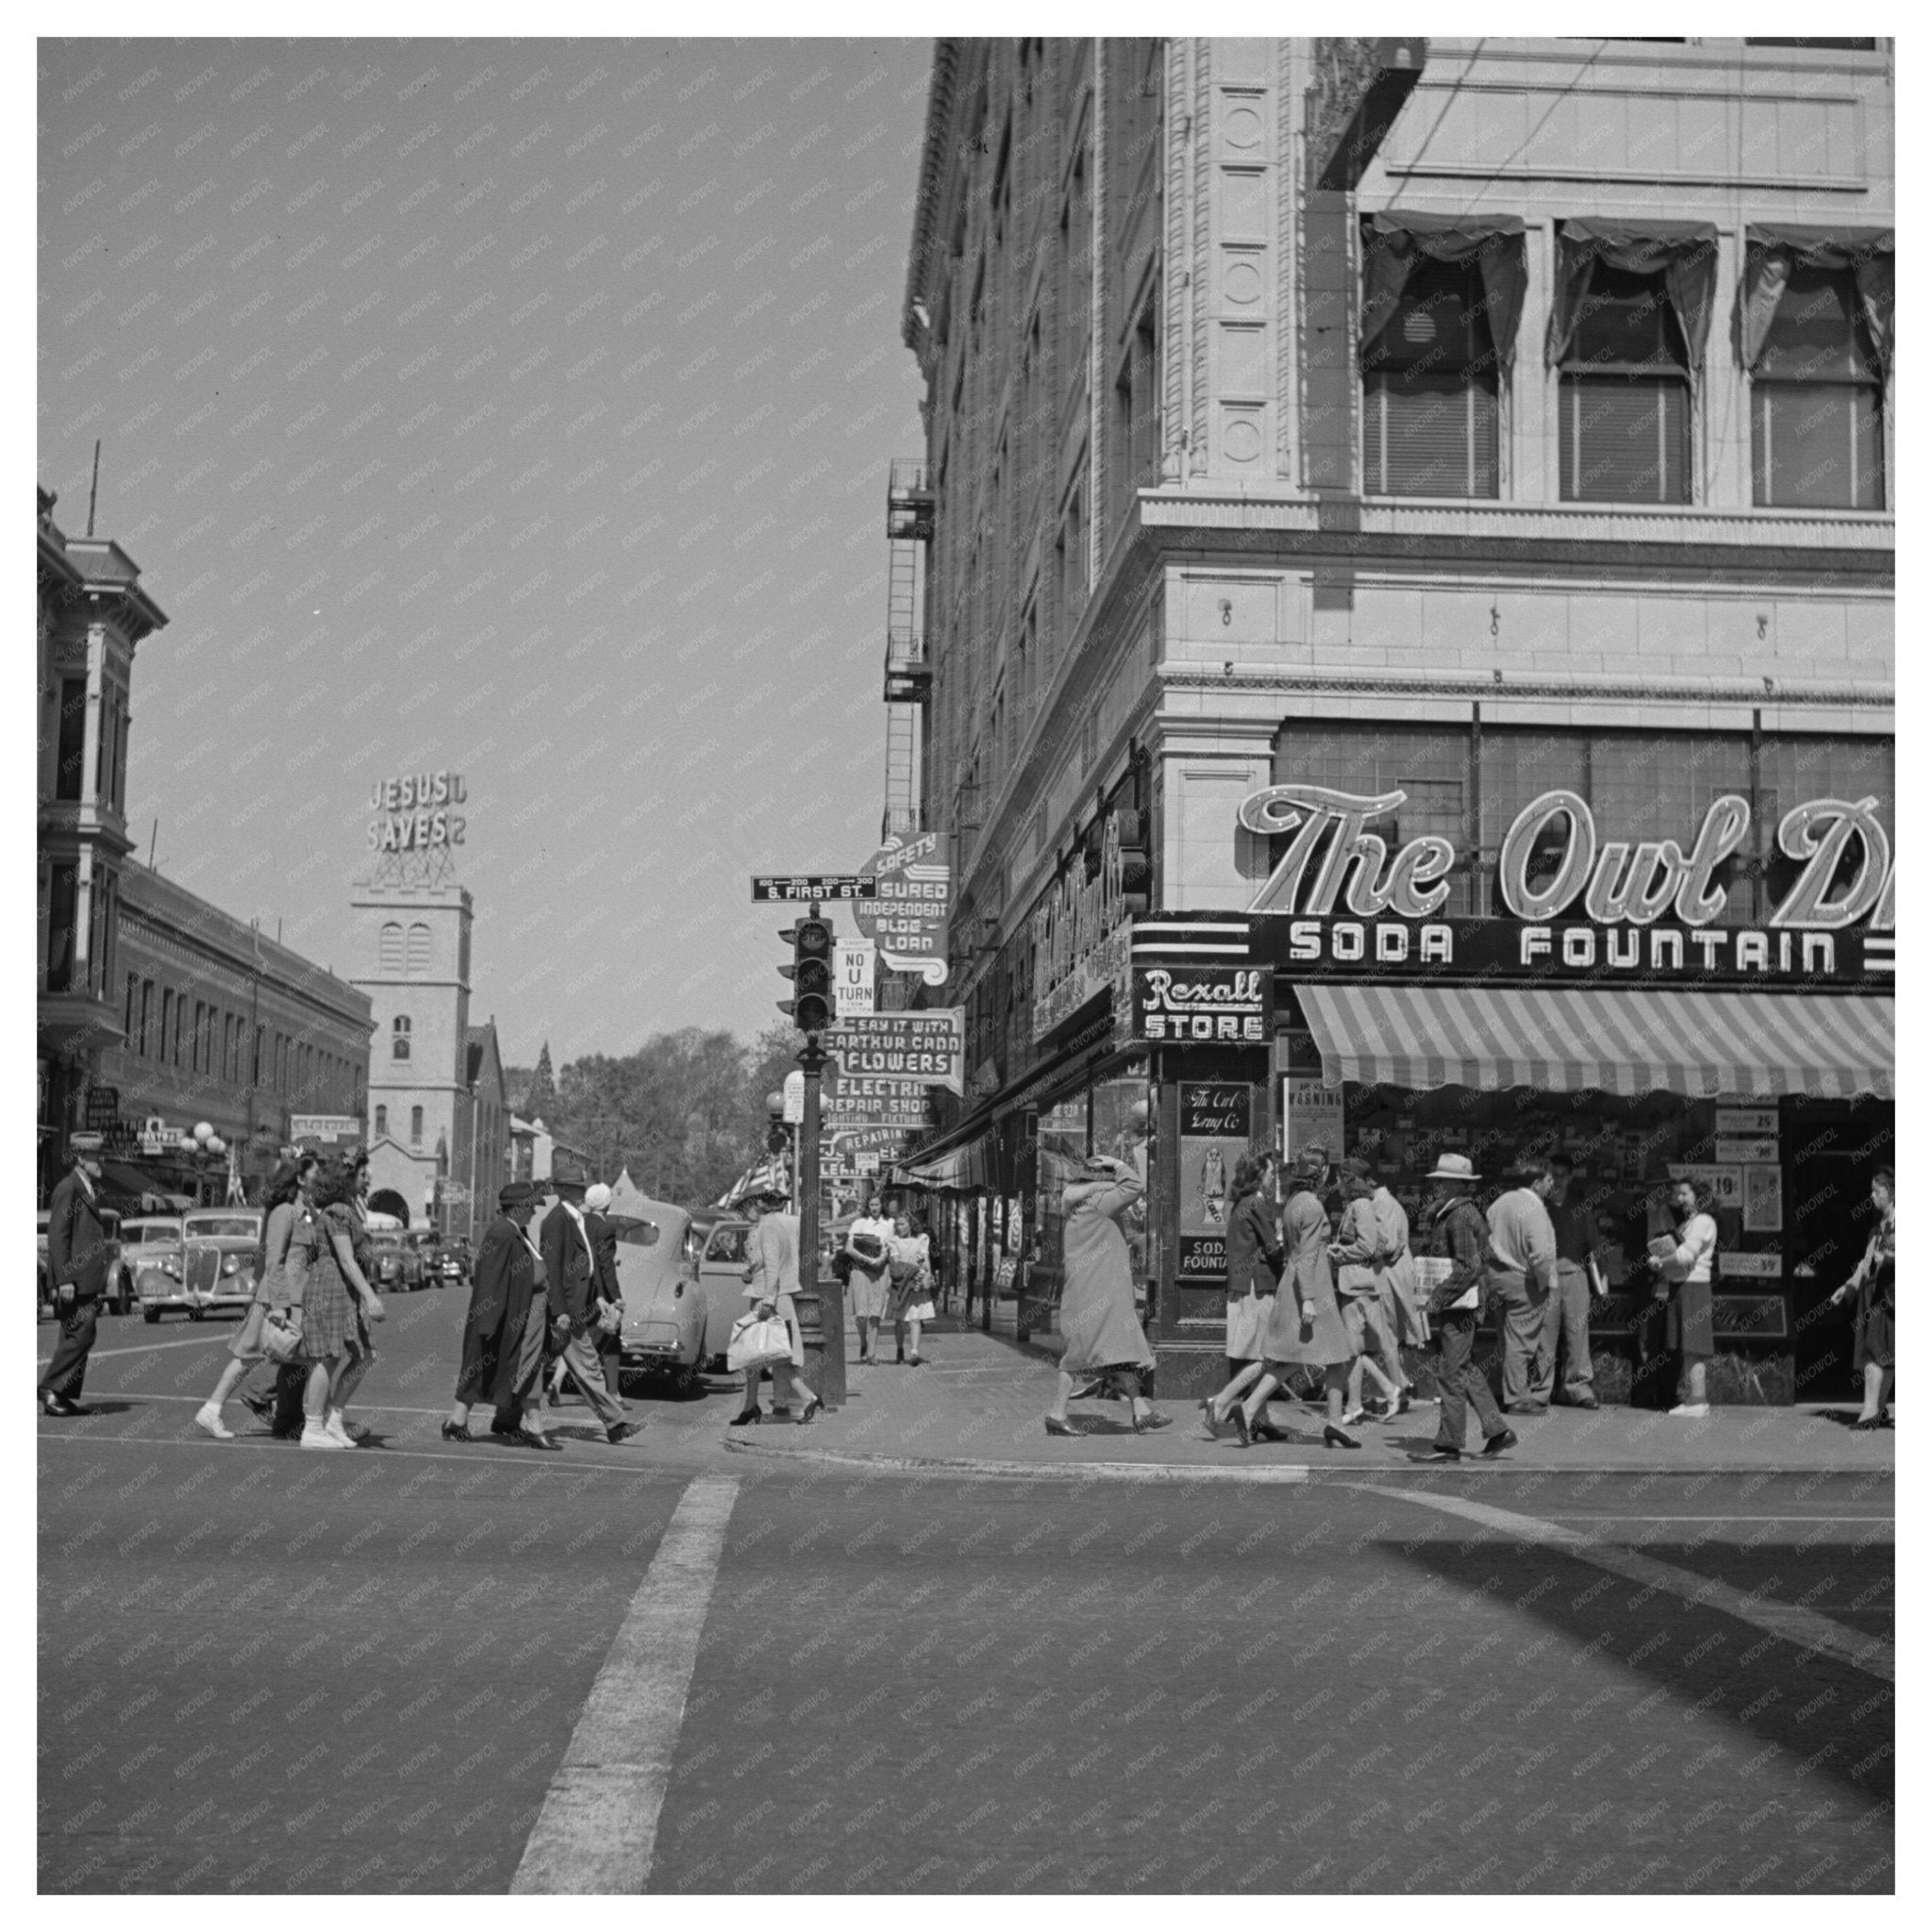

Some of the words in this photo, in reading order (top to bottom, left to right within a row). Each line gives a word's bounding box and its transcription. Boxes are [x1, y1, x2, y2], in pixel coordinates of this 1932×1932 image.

[369, 770, 448, 811] JESUS
[367, 811, 447, 852] SAVES
[876, 833, 937, 878] SAFETY
[1238, 784, 1407, 917] The
[1501, 790, 1750, 925] Owl
[768, 887, 781, 899] S.
[786, 885, 833, 898] FIRST
[841, 885, 862, 897] ST.
[859, 901, 948, 916] INDEPENDENT
[885, 935, 932, 950] LOAN
[1290, 922, 1453, 963] SODA
[1521, 926, 1835, 973] FOUNTAIN
[846, 953, 864, 967] NO
[849, 969, 861, 985] U
[838, 987, 873, 1000] TURN
[1142, 970, 1262, 1011] Rexall
[858, 1019, 889, 1031] SAY
[893, 1021, 908, 1032] IT
[912, 1021, 949, 1033] WITH
[1145, 1015, 1263, 1040] STORE
[836, 1034, 906, 1049] ARTHUR
[912, 1036, 959, 1050] CANN
[848, 1052, 948, 1072] FLOWERS
[827, 1098, 883, 1113] REPAIR
[889, 1099, 931, 1113] SHOP
[822, 1112, 869, 1124] IGHTING
[845, 1128, 909, 1150] REPAIRING
[1193, 1241, 1226, 1255] SOD
